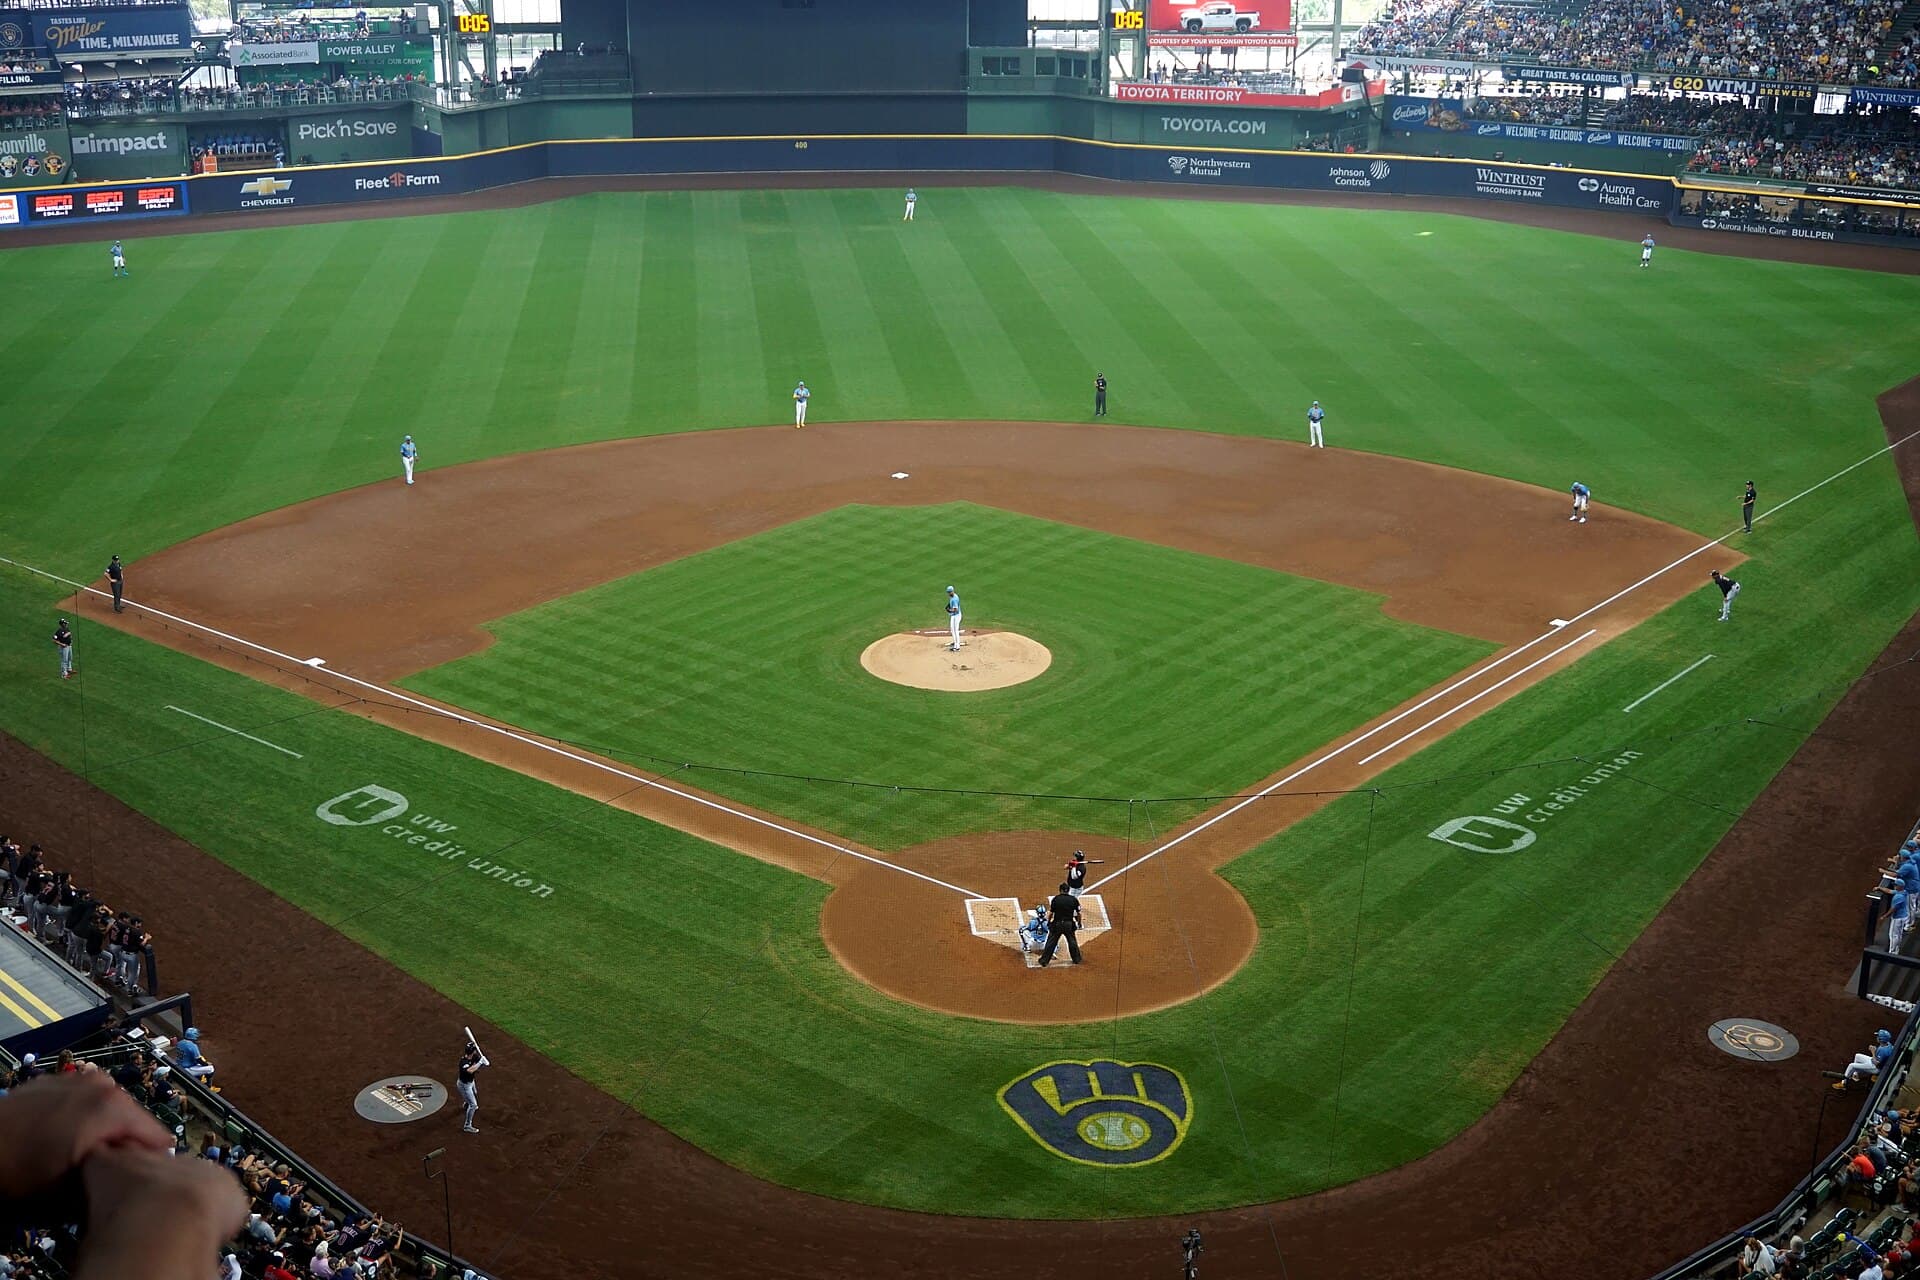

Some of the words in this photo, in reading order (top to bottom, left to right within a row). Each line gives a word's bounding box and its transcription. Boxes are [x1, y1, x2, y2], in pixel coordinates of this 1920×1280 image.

[50, 17, 72, 25] TASTES
[73, 17, 87, 25] LIKE
[459, 15, 490, 32] 0:05
[1115, 11, 1143, 29] 0:05
[46, 21, 106, 49] Miller
[79, 37, 111, 50] TIME,
[112, 34, 180, 48] MILWAUKEE
[326, 45, 363, 56] POWER
[365, 44, 395, 54] ALLEY
[1520, 69, 1544, 78] GREAT
[1545, 70, 1568, 80] TASTE.
[1569, 72, 1580, 80] 96
[1581, 73, 1619, 83] CALORIES.
[1673, 77, 1704, 90] 620
[1706, 79, 1756, 95] WTMJ
[1760, 88, 1812, 98] BREWERS
[1120, 86, 1171, 99] TOYOTA
[1172, 88, 1243, 101] TERRITORY
[1856, 90, 1915, 104] WINTRUST
[353, 121, 397, 136] Save
[1161, 117, 1266, 135] TOYOTA.COM
[1505, 125, 1538, 138] WELCOME
[1549, 129, 1583, 142] DELICIOUS
[1618, 134, 1652, 147] WELCOME
[88, 132, 168, 155] impact
[795, 141, 808, 149] 400
[1189, 158, 1251, 169] Northwestern
[1189, 166, 1221, 176] Mutual
[1329, 167, 1365, 177] Johnson
[1476, 168, 1547, 187] WINTRUST
[355, 176, 389, 190] Fleet
[406, 174, 440, 187] Farm
[1335, 177, 1371, 187] Controls
[1600, 182, 1635, 195] Aurora
[86, 191, 124, 204] ESPN
[138, 188, 174, 200] ESPN
[1476, 186, 1523, 196] WISCONSIN'S
[1523, 190, 1543, 198] BANK
[1836, 189, 1869, 197] Aurora
[1871, 192, 1904, 200] Health
[36, 194, 73, 207] ESPN
[241, 197, 295, 207] CHEVROLET
[1599, 193, 1633, 206] Health
[1635, 196, 1660, 208] Care
[1717, 222, 1742, 232] Aurora
[1743, 224, 1767, 234] Health
[1769, 226, 1787, 236] Care
[1791, 228, 1835, 241] BULLPEN
[1525, 786, 1588, 823] credit
[1580, 749, 1644, 785] union
[1493, 793, 1531, 814] uw
[410, 813, 458, 834] uw
[382, 825, 466, 860] credit
[467, 857, 555, 898] union
